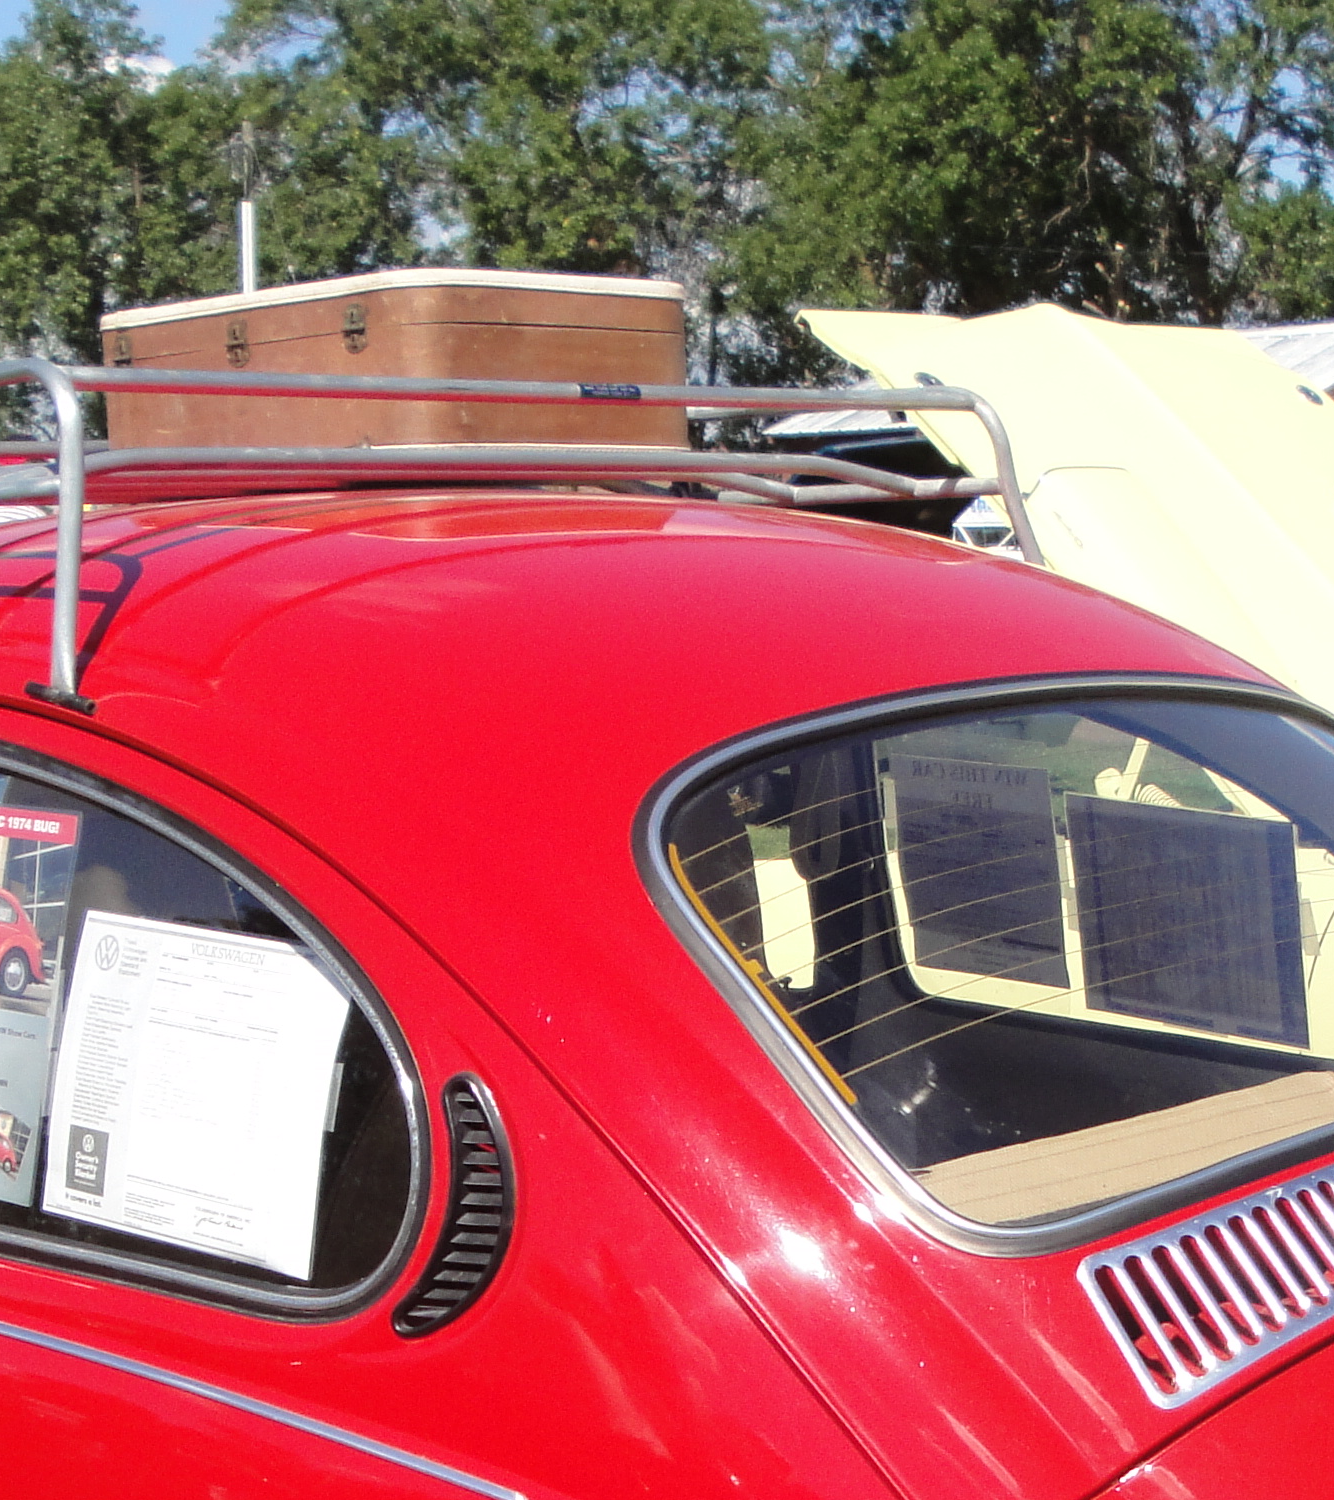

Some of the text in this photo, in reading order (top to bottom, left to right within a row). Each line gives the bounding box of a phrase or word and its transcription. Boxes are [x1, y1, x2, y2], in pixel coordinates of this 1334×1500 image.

[7, 816, 32, 831] 1974
[33, 819, 60, 834] BUG!
[191, 943, 266, 966] VOLKSWAGEN
